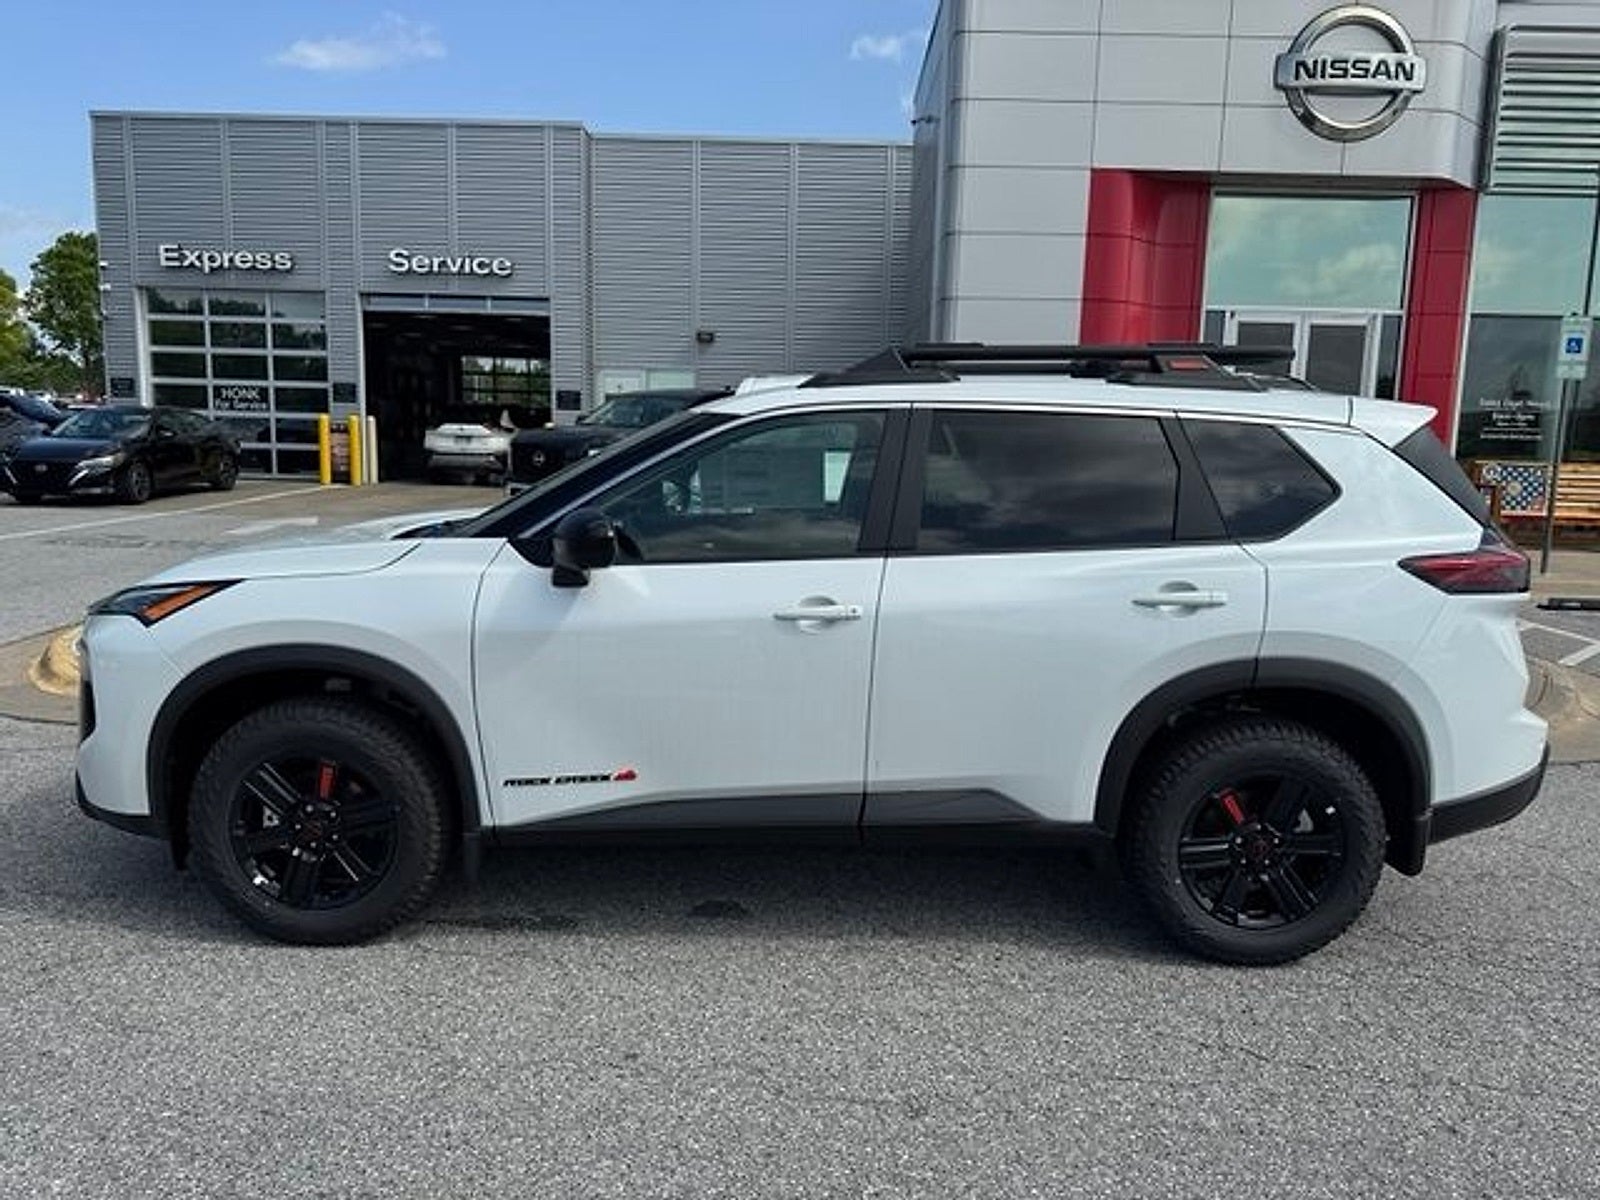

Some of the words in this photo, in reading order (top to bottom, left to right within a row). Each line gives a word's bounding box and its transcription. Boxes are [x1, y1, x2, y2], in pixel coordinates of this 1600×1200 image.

[1294, 59, 1415, 81] NISSAN
[159, 244, 293, 274] Express
[388, 248, 513, 276] Service
[220, 387, 261, 400] HONK
